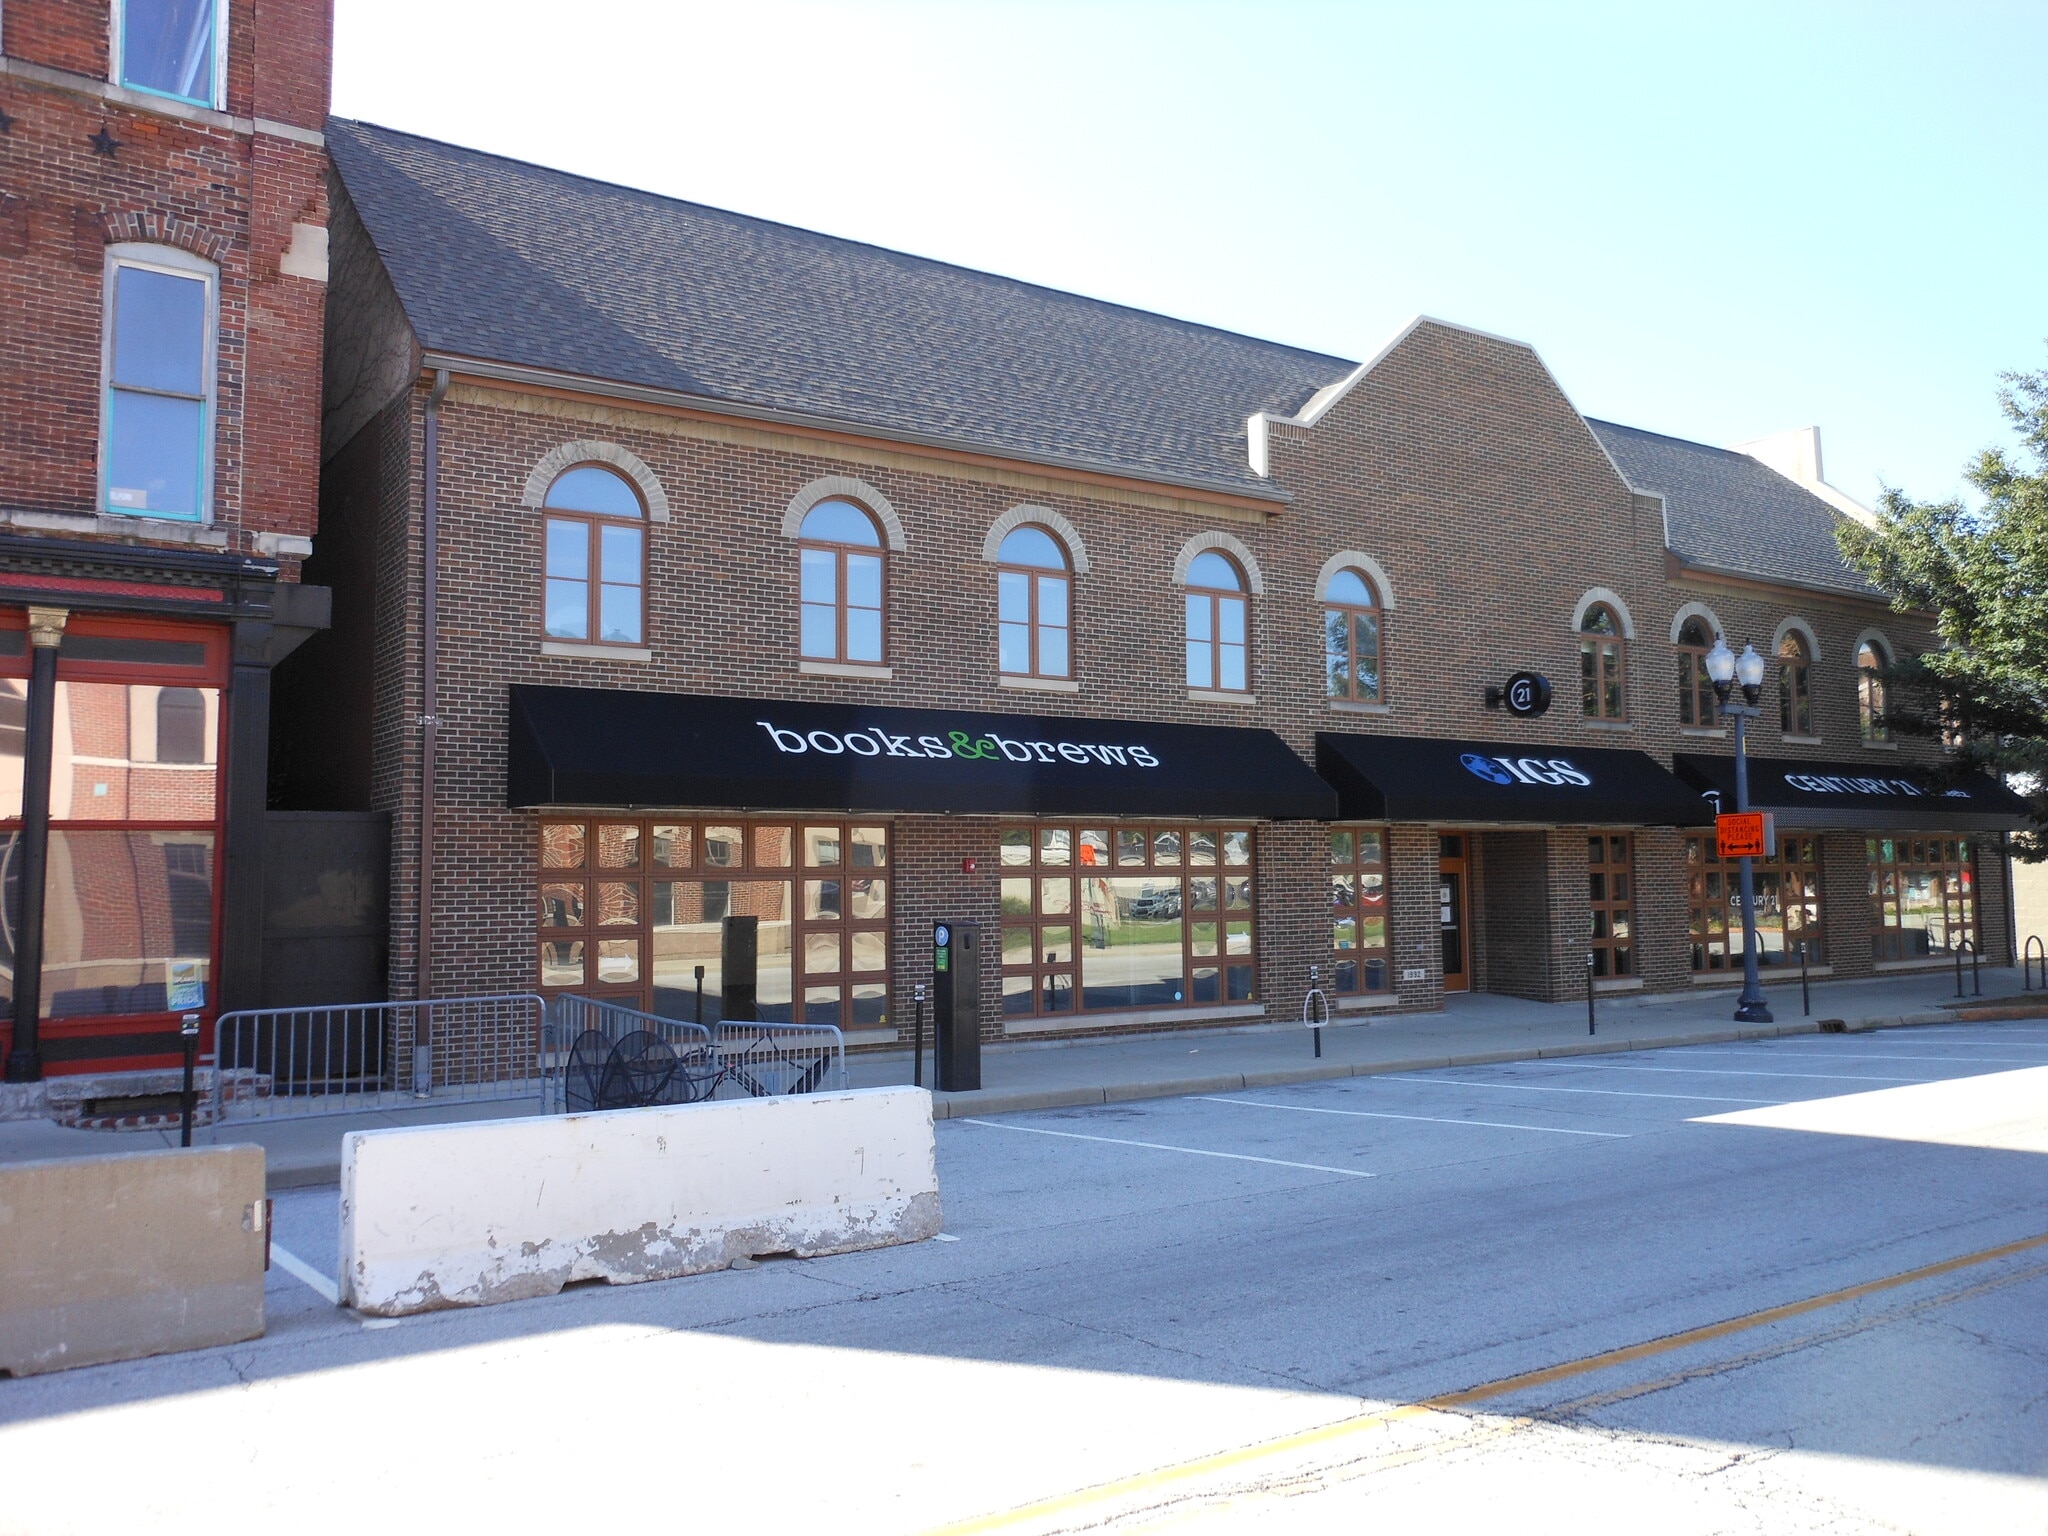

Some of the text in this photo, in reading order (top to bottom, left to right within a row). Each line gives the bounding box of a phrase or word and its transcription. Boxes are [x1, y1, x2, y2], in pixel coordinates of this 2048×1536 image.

[756, 721, 1160, 768] books&brews
[1492, 757, 1591, 786] IGS
[1783, 773, 1898, 796] CENTURY
[1890, 779, 1922, 796] 21
[1727, 818, 1751, 826] SOCIAL
[1719, 825, 1760, 834] DISTANCING
[1727, 832, 1753, 841] PLEASE
[1730, 895, 1769, 906] CEURY
